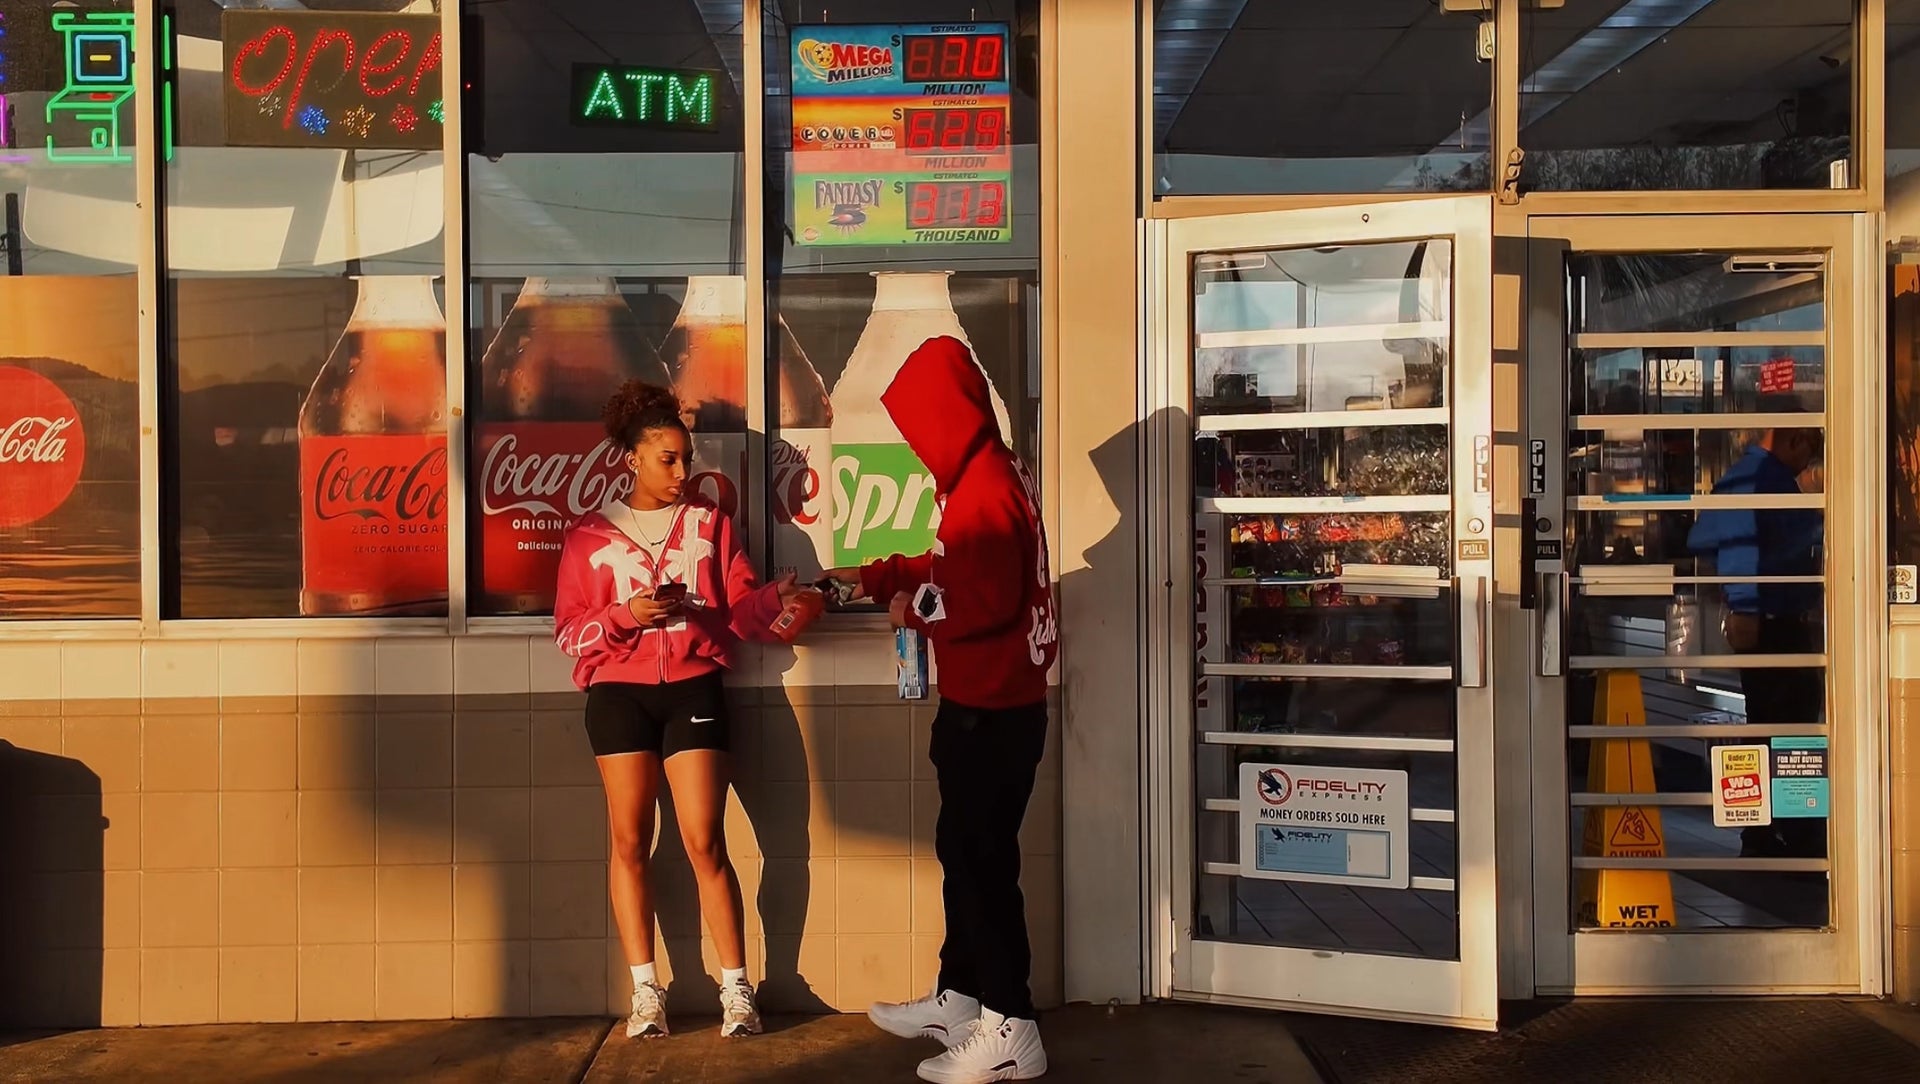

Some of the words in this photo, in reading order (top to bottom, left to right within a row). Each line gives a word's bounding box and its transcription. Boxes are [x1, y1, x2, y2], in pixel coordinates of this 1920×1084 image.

[891, 34, 900, 47] $
[831, 43, 893, 68] MEGA
[828, 65, 894, 83] MILLIONS
[584, 71, 709, 122] ATM
[922, 84, 986, 95] MILLION
[893, 108, 902, 121] $
[924, 157, 987, 168] MILLION
[815, 180, 885, 209] FANTASY
[894, 182, 904, 194] $
[912, 183, 1004, 226] 313
[828, 204, 867, 226] 5
[914, 230, 1000, 243] THOUSAND
[772, 439, 811, 465] Diet
[1475, 436, 1489, 493] PULL
[1531, 441, 1544, 493] PULL
[480, 433, 635, 516] Coca-Co
[352, 525, 390, 534] ZERO
[517, 541, 562, 550] Delicious
[1463, 544, 1485, 554] PULL
[1537, 545, 1557, 555] PULL
[1296, 779, 1387, 793] FIDELITY
[1728, 776, 1754, 788] We
[1299, 792, 1382, 801] EXPRESS
[1723, 785, 1760, 800] Card
[1260, 808, 1293, 820] MONEY
[1296, 811, 1332, 822] ORDERS
[1335, 812, 1359, 823] SOLD
[1363, 814, 1385, 825] HERE
[1288, 831, 1333, 839] FIDELITY
[1619, 905, 1659, 919] WET
